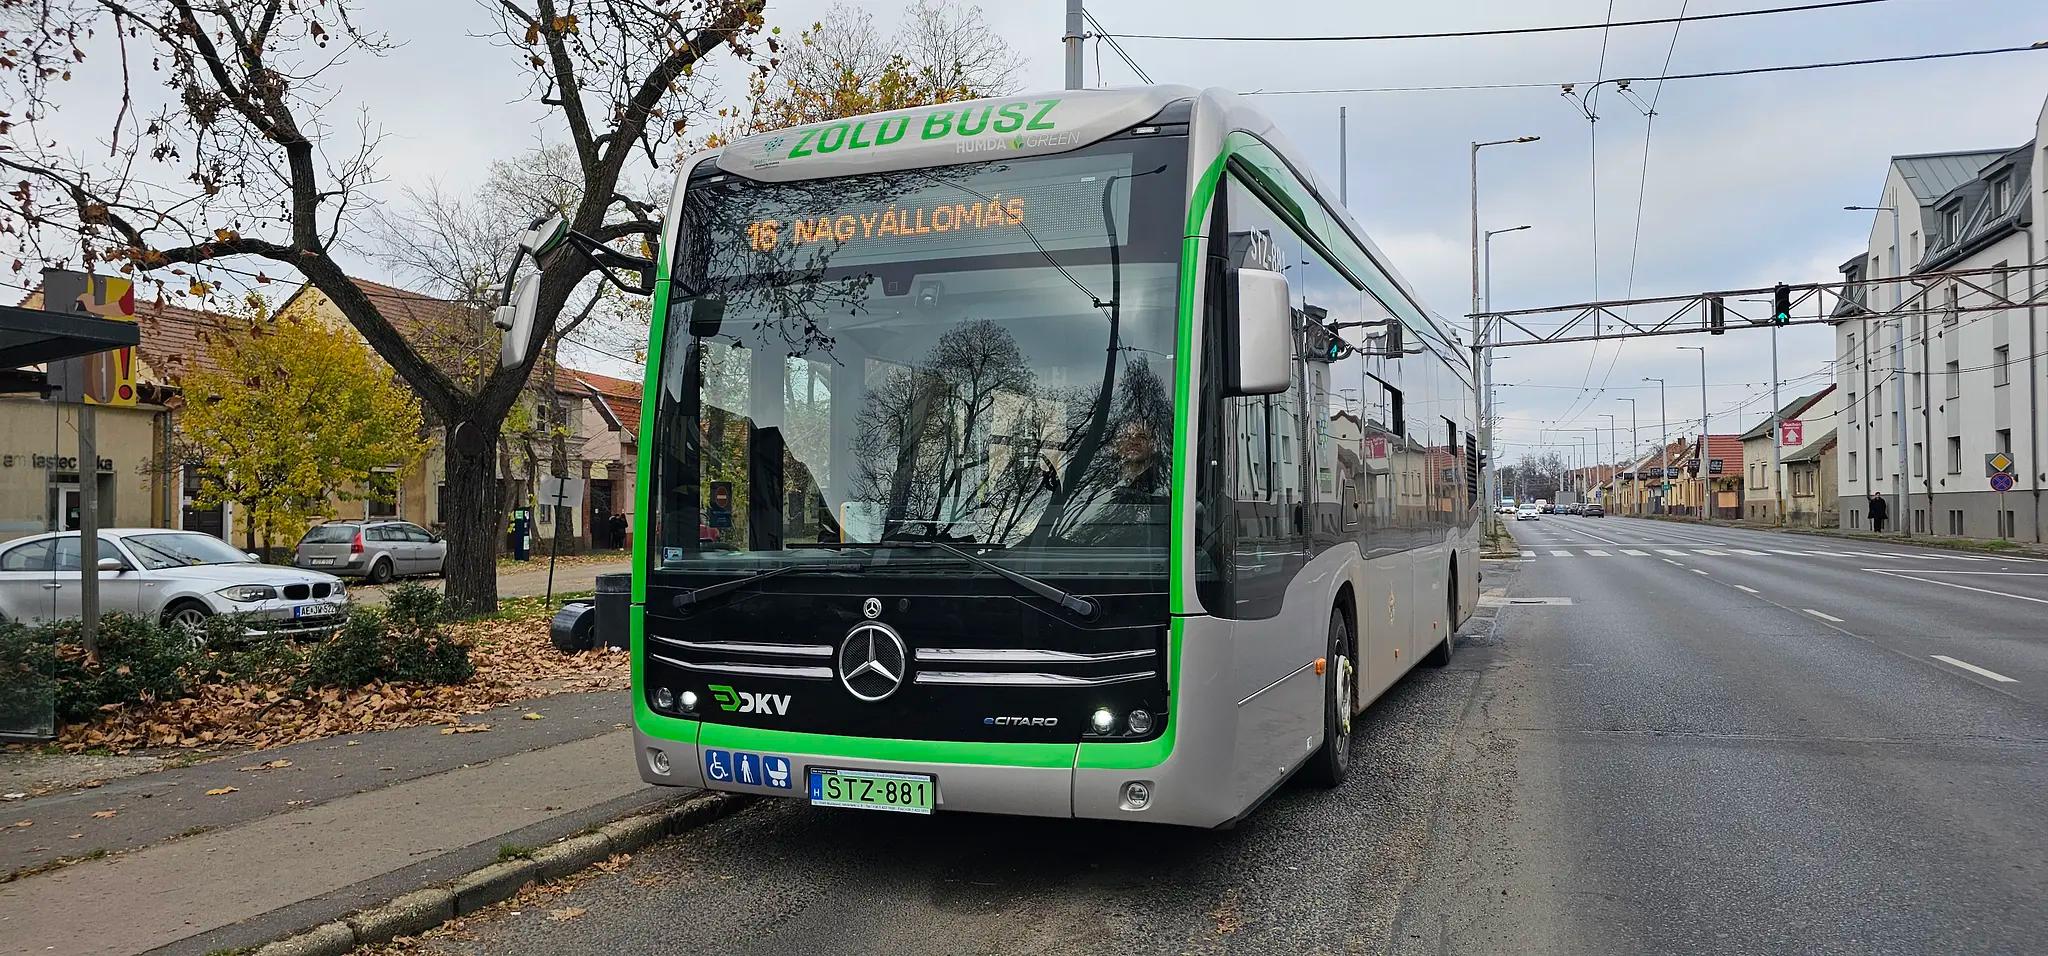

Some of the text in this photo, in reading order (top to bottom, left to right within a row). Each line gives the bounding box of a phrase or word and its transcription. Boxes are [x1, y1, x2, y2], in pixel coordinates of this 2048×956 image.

[921, 98, 1062, 141] BUSZ
[956, 131, 1080, 154] HUMDA GREEN
[747, 192, 1025, 251] 16 NAGYÁLLOMÁS
[738, 691, 792, 716] DKV
[983, 716, 1058, 726] eCITARO
[813, 788, 820, 797] H
[827, 776, 925, 806] STZ-881
